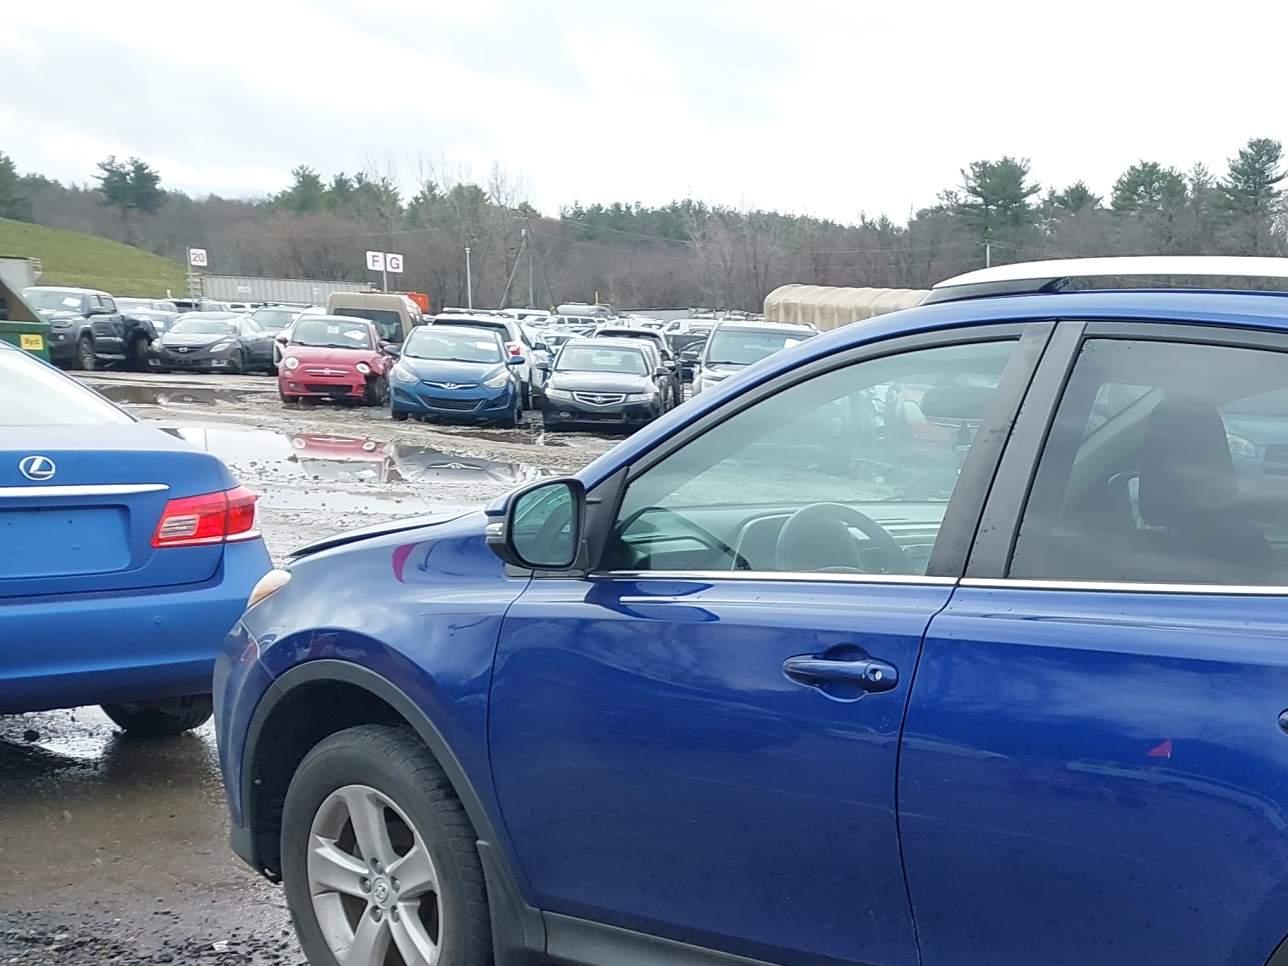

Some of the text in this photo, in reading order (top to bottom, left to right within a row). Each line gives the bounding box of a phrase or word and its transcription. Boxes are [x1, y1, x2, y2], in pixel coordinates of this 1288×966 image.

[191, 252, 205, 263] 20
[371, 254, 380, 267] F
[390, 256, 400, 270] G
